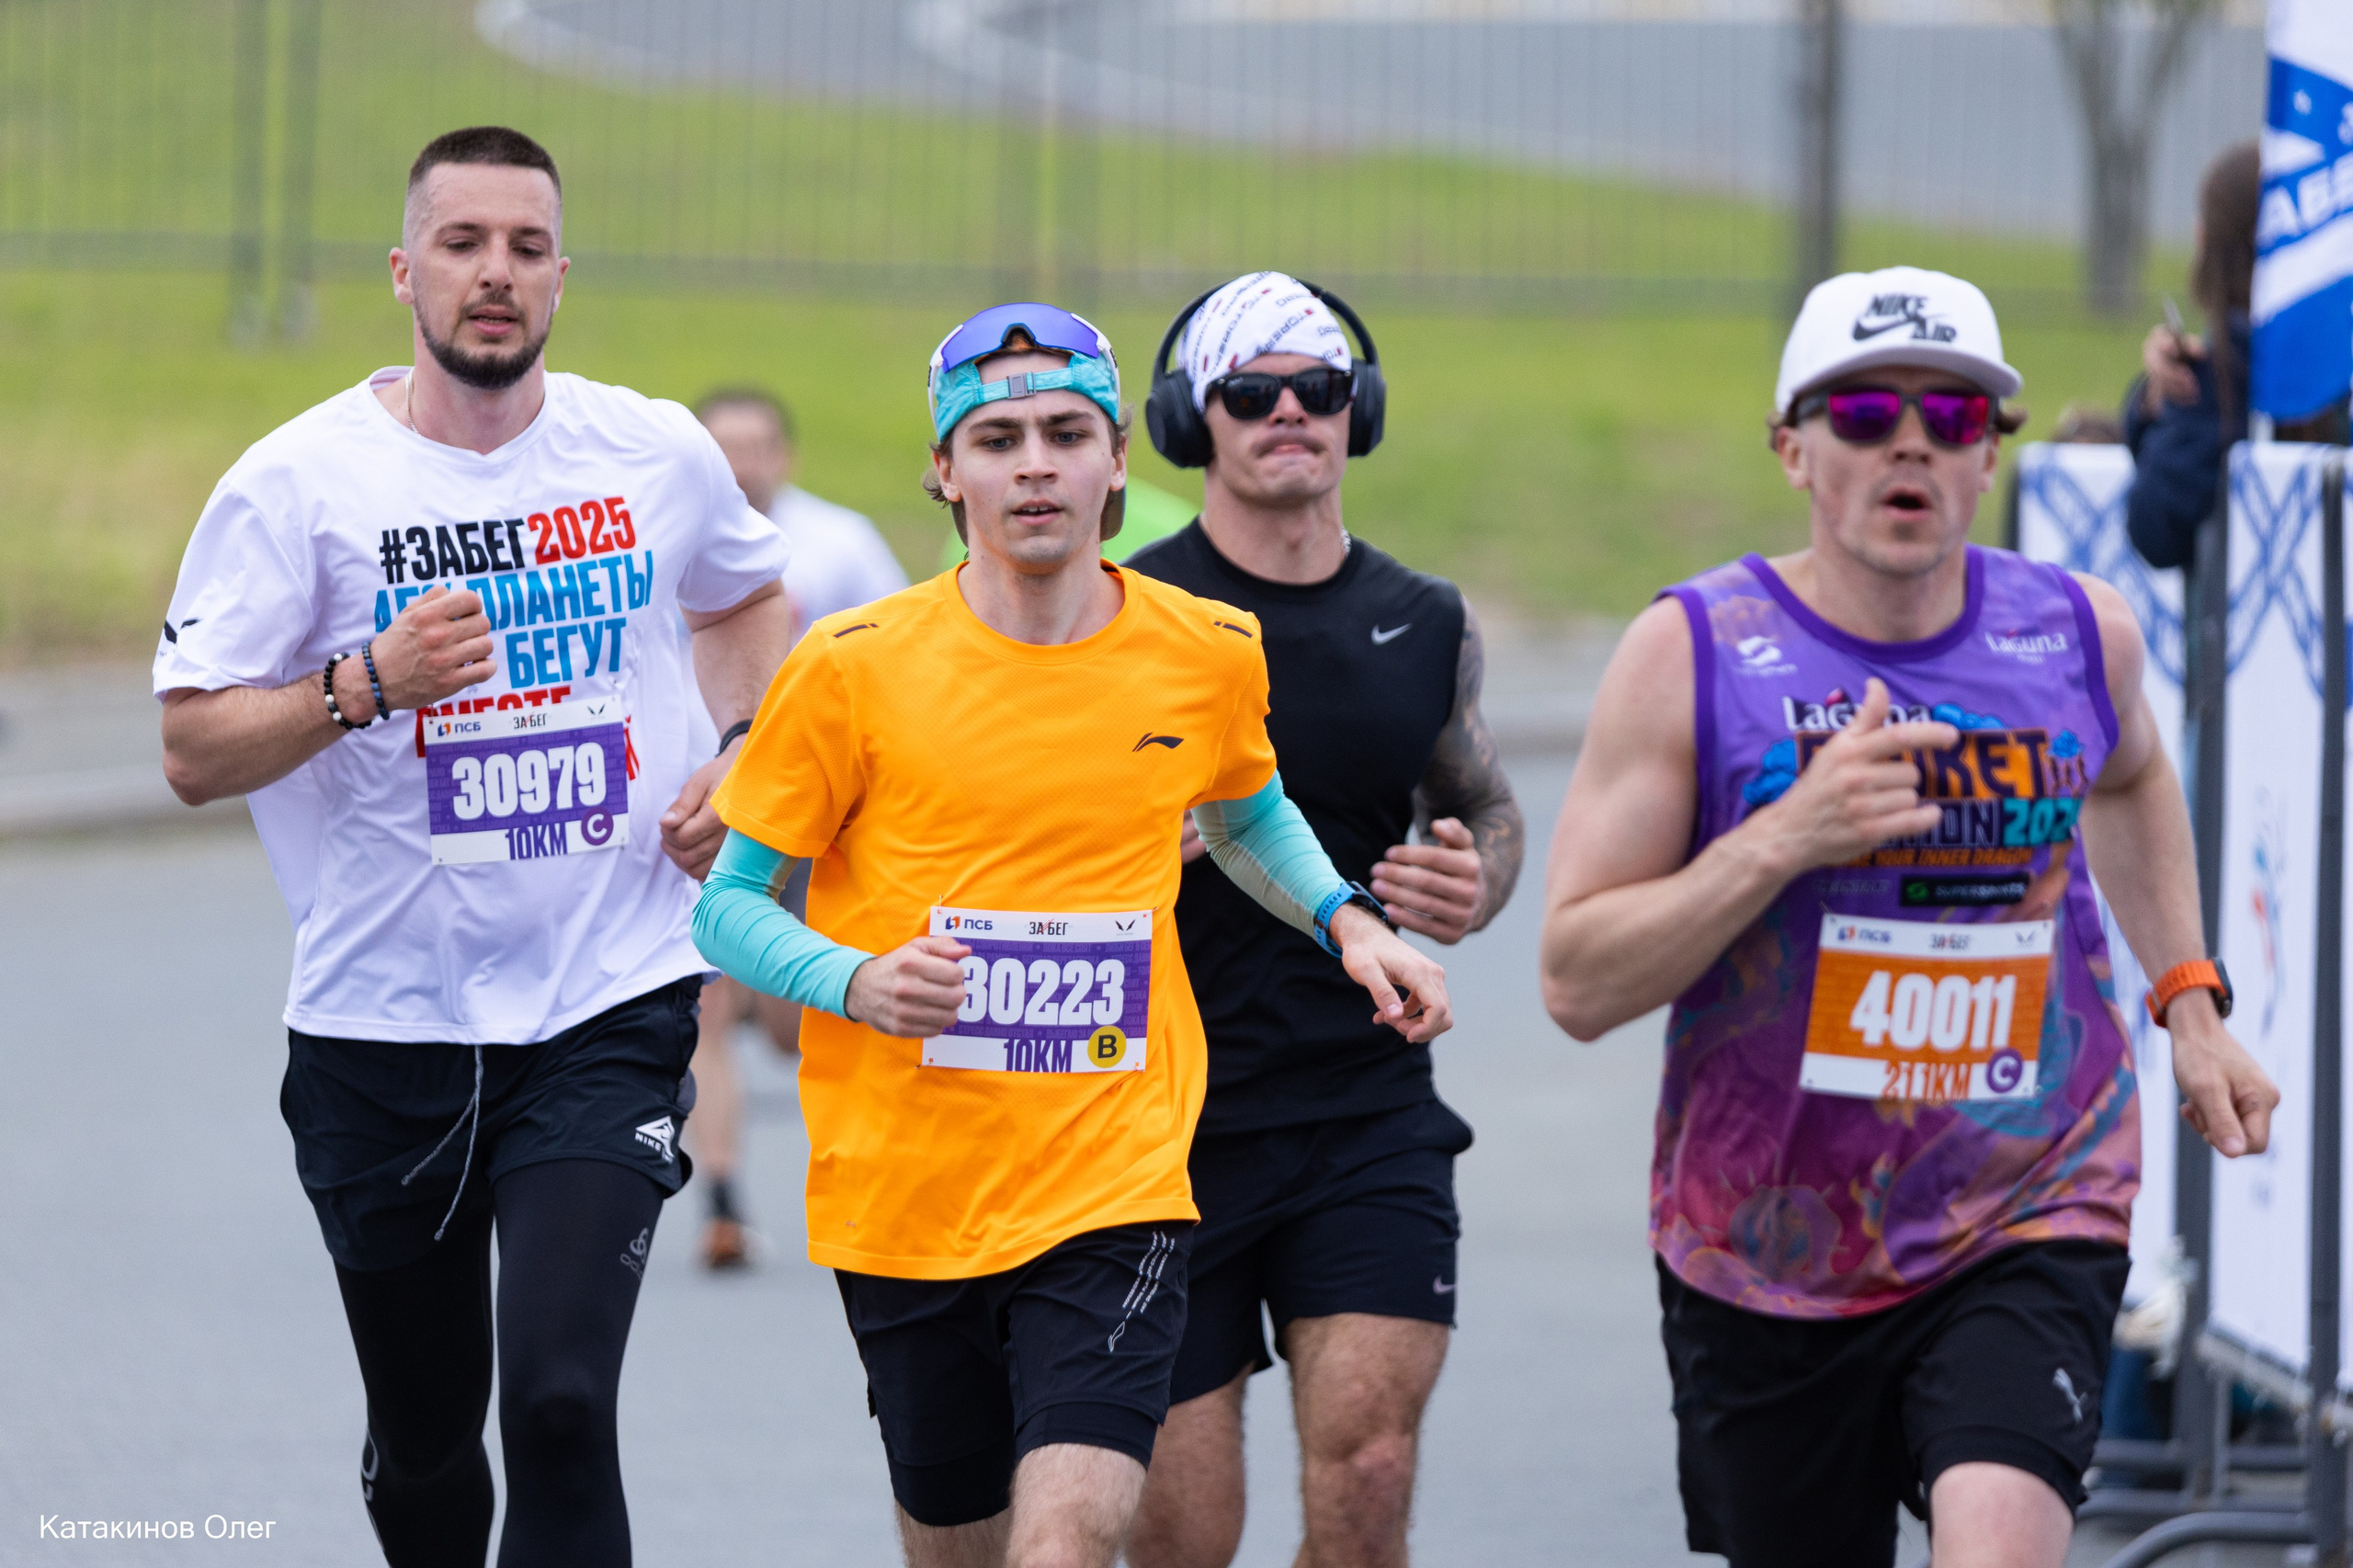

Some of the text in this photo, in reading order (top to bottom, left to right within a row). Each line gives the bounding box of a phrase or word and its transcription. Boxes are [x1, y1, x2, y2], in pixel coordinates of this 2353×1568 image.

[505, 617, 627, 689] БЕГУТ
[454, 721, 482, 733] ПСБ
[451, 741, 607, 821] 30979
[963, 919, 994, 931] ПСБ
[956, 955, 1126, 1026] 30223
[1848, 969, 2018, 1052] 40011
[1097, 1035, 1118, 1059] B
[634, 1131, 662, 1152] NIKE
